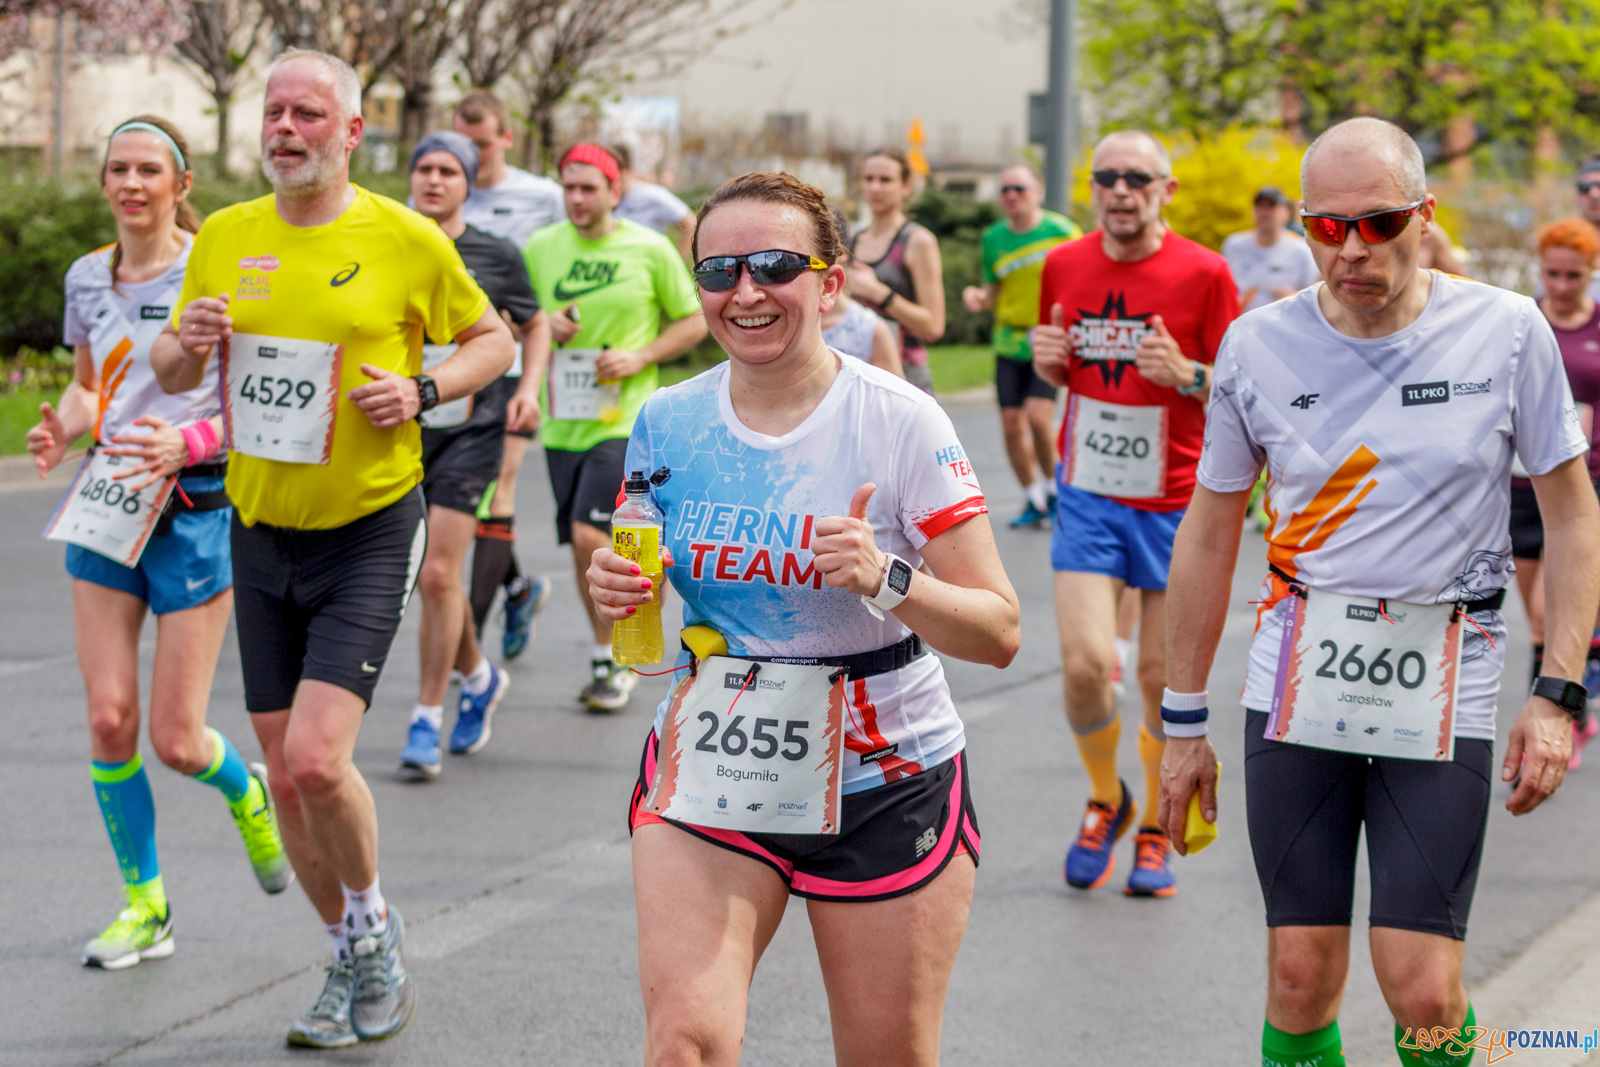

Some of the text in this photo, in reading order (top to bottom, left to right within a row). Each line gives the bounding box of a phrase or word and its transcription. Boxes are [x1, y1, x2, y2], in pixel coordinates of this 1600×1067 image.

[567, 260, 619, 283] RUN
[236, 287, 271, 295] EKIDEN
[1068, 325, 1157, 349] CHICAG
[240, 374, 316, 410] 4529
[1290, 393, 1320, 409] 4F
[1084, 430, 1149, 459] 4220
[80, 479, 142, 514] 4806
[675, 500, 814, 549] HERNI
[690, 543, 823, 590] TEAM
[771, 657, 818, 665] compressport
[1315, 639, 1426, 690] 2660
[1337, 691, 1394, 708] Jarosław
[695, 710, 809, 761] 2655
[716, 764, 779, 782] Bogumiła
[746, 803, 763, 811] 4F
